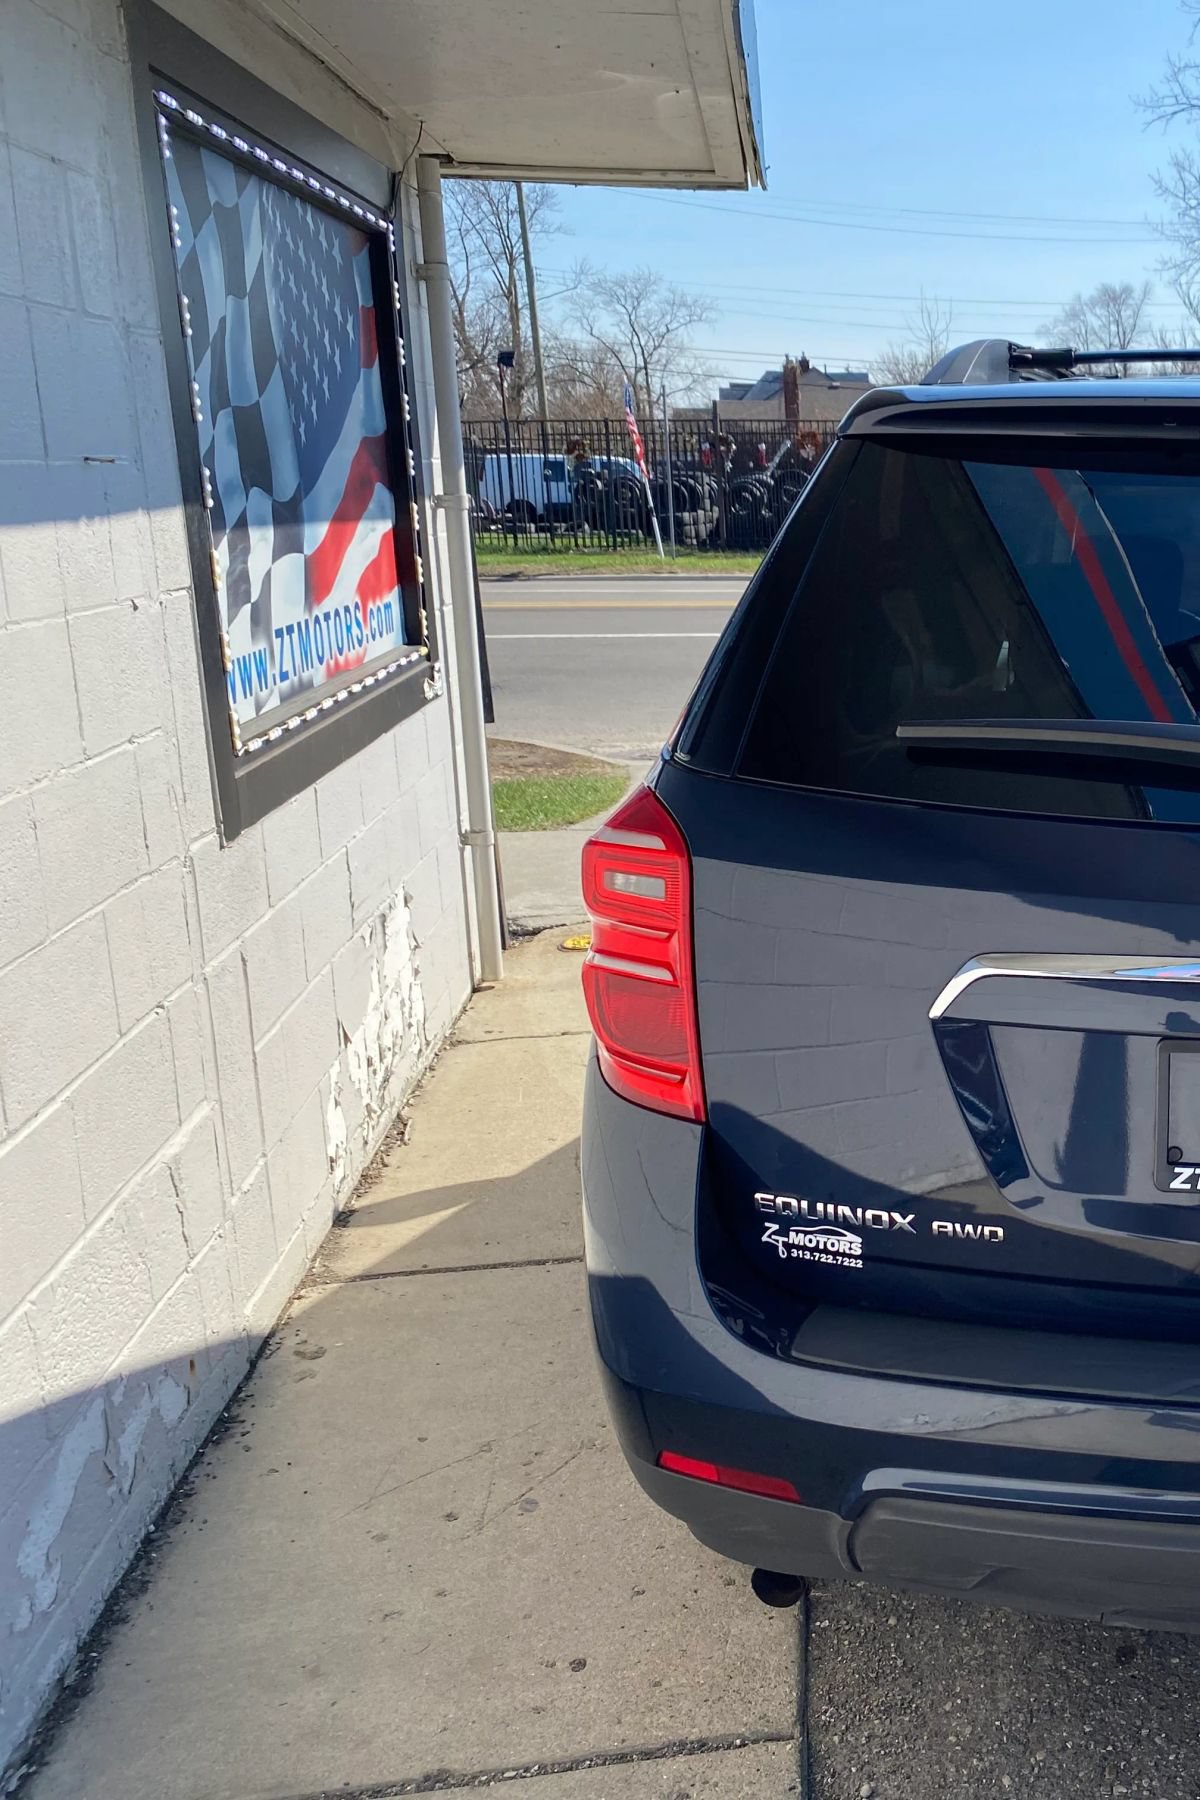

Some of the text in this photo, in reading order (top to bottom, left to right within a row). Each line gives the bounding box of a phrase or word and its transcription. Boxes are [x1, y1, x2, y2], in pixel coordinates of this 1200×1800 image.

[753, 1192, 1004, 1242] EQUINOX AWD
[788, 1231, 863, 1256] MOTORS
[790, 1248, 863, 1268] 313.722.7222
